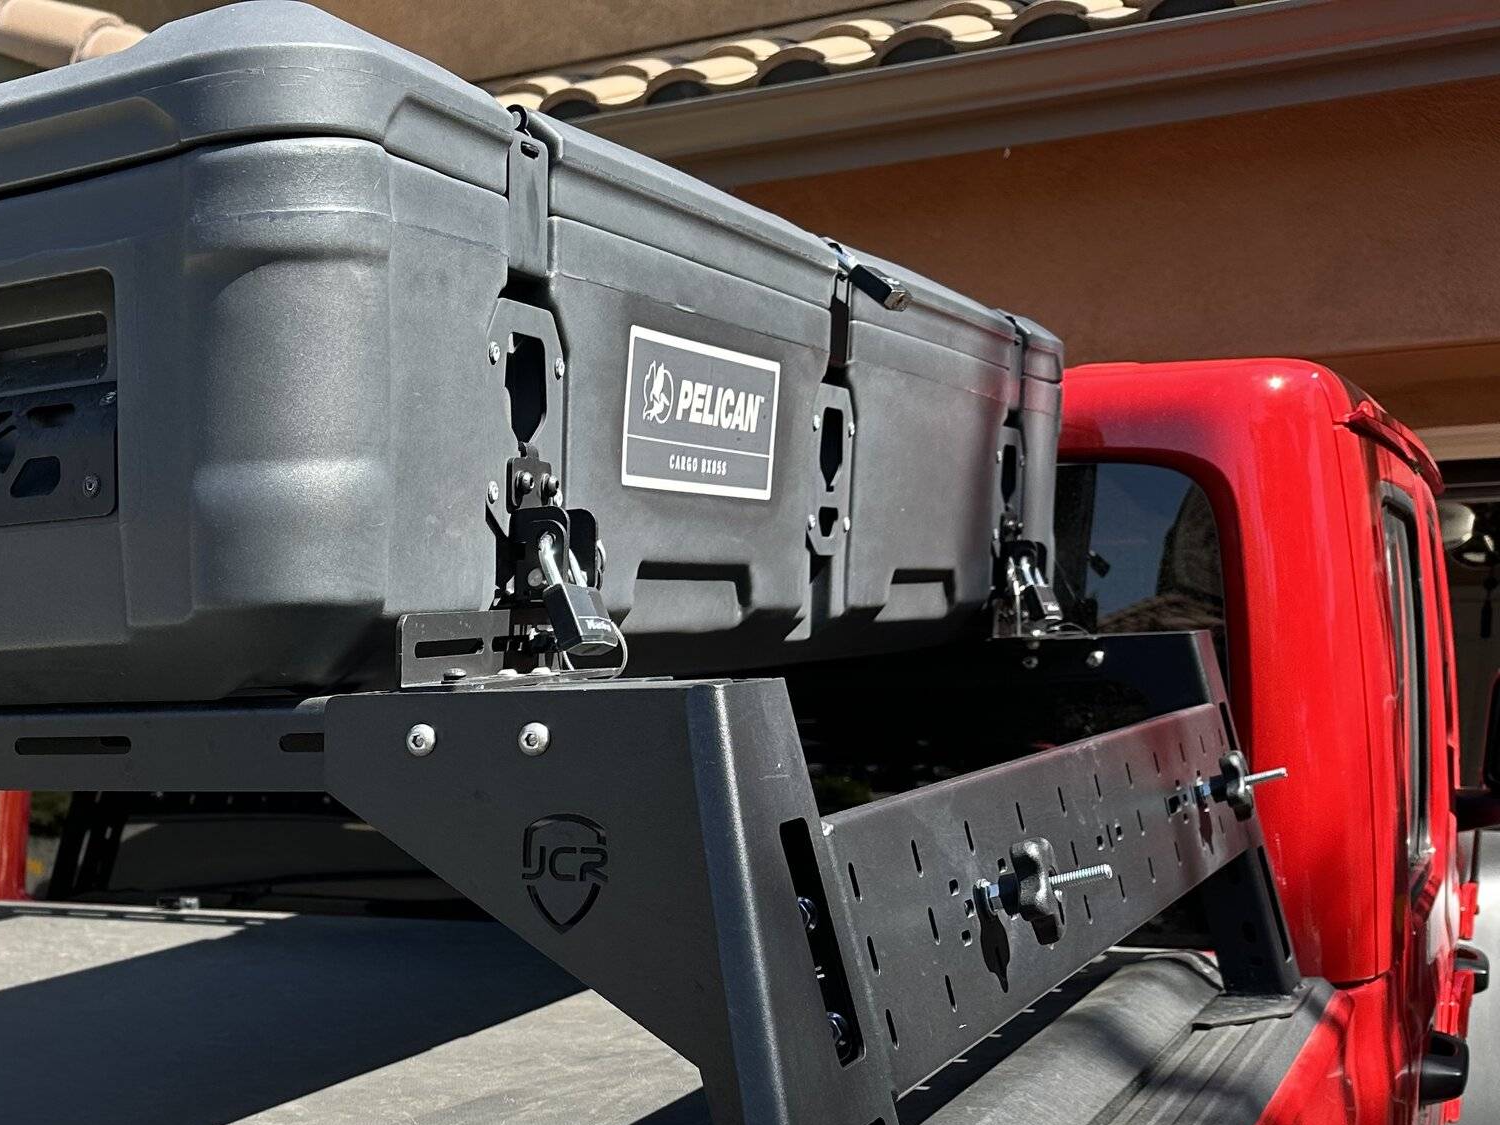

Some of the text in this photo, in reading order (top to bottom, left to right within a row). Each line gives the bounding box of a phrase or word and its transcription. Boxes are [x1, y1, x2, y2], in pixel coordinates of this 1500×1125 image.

[676, 379, 758, 433] PELICAN
[669, 454, 698, 472] CARGO
[521, 845, 609, 883] JCR
